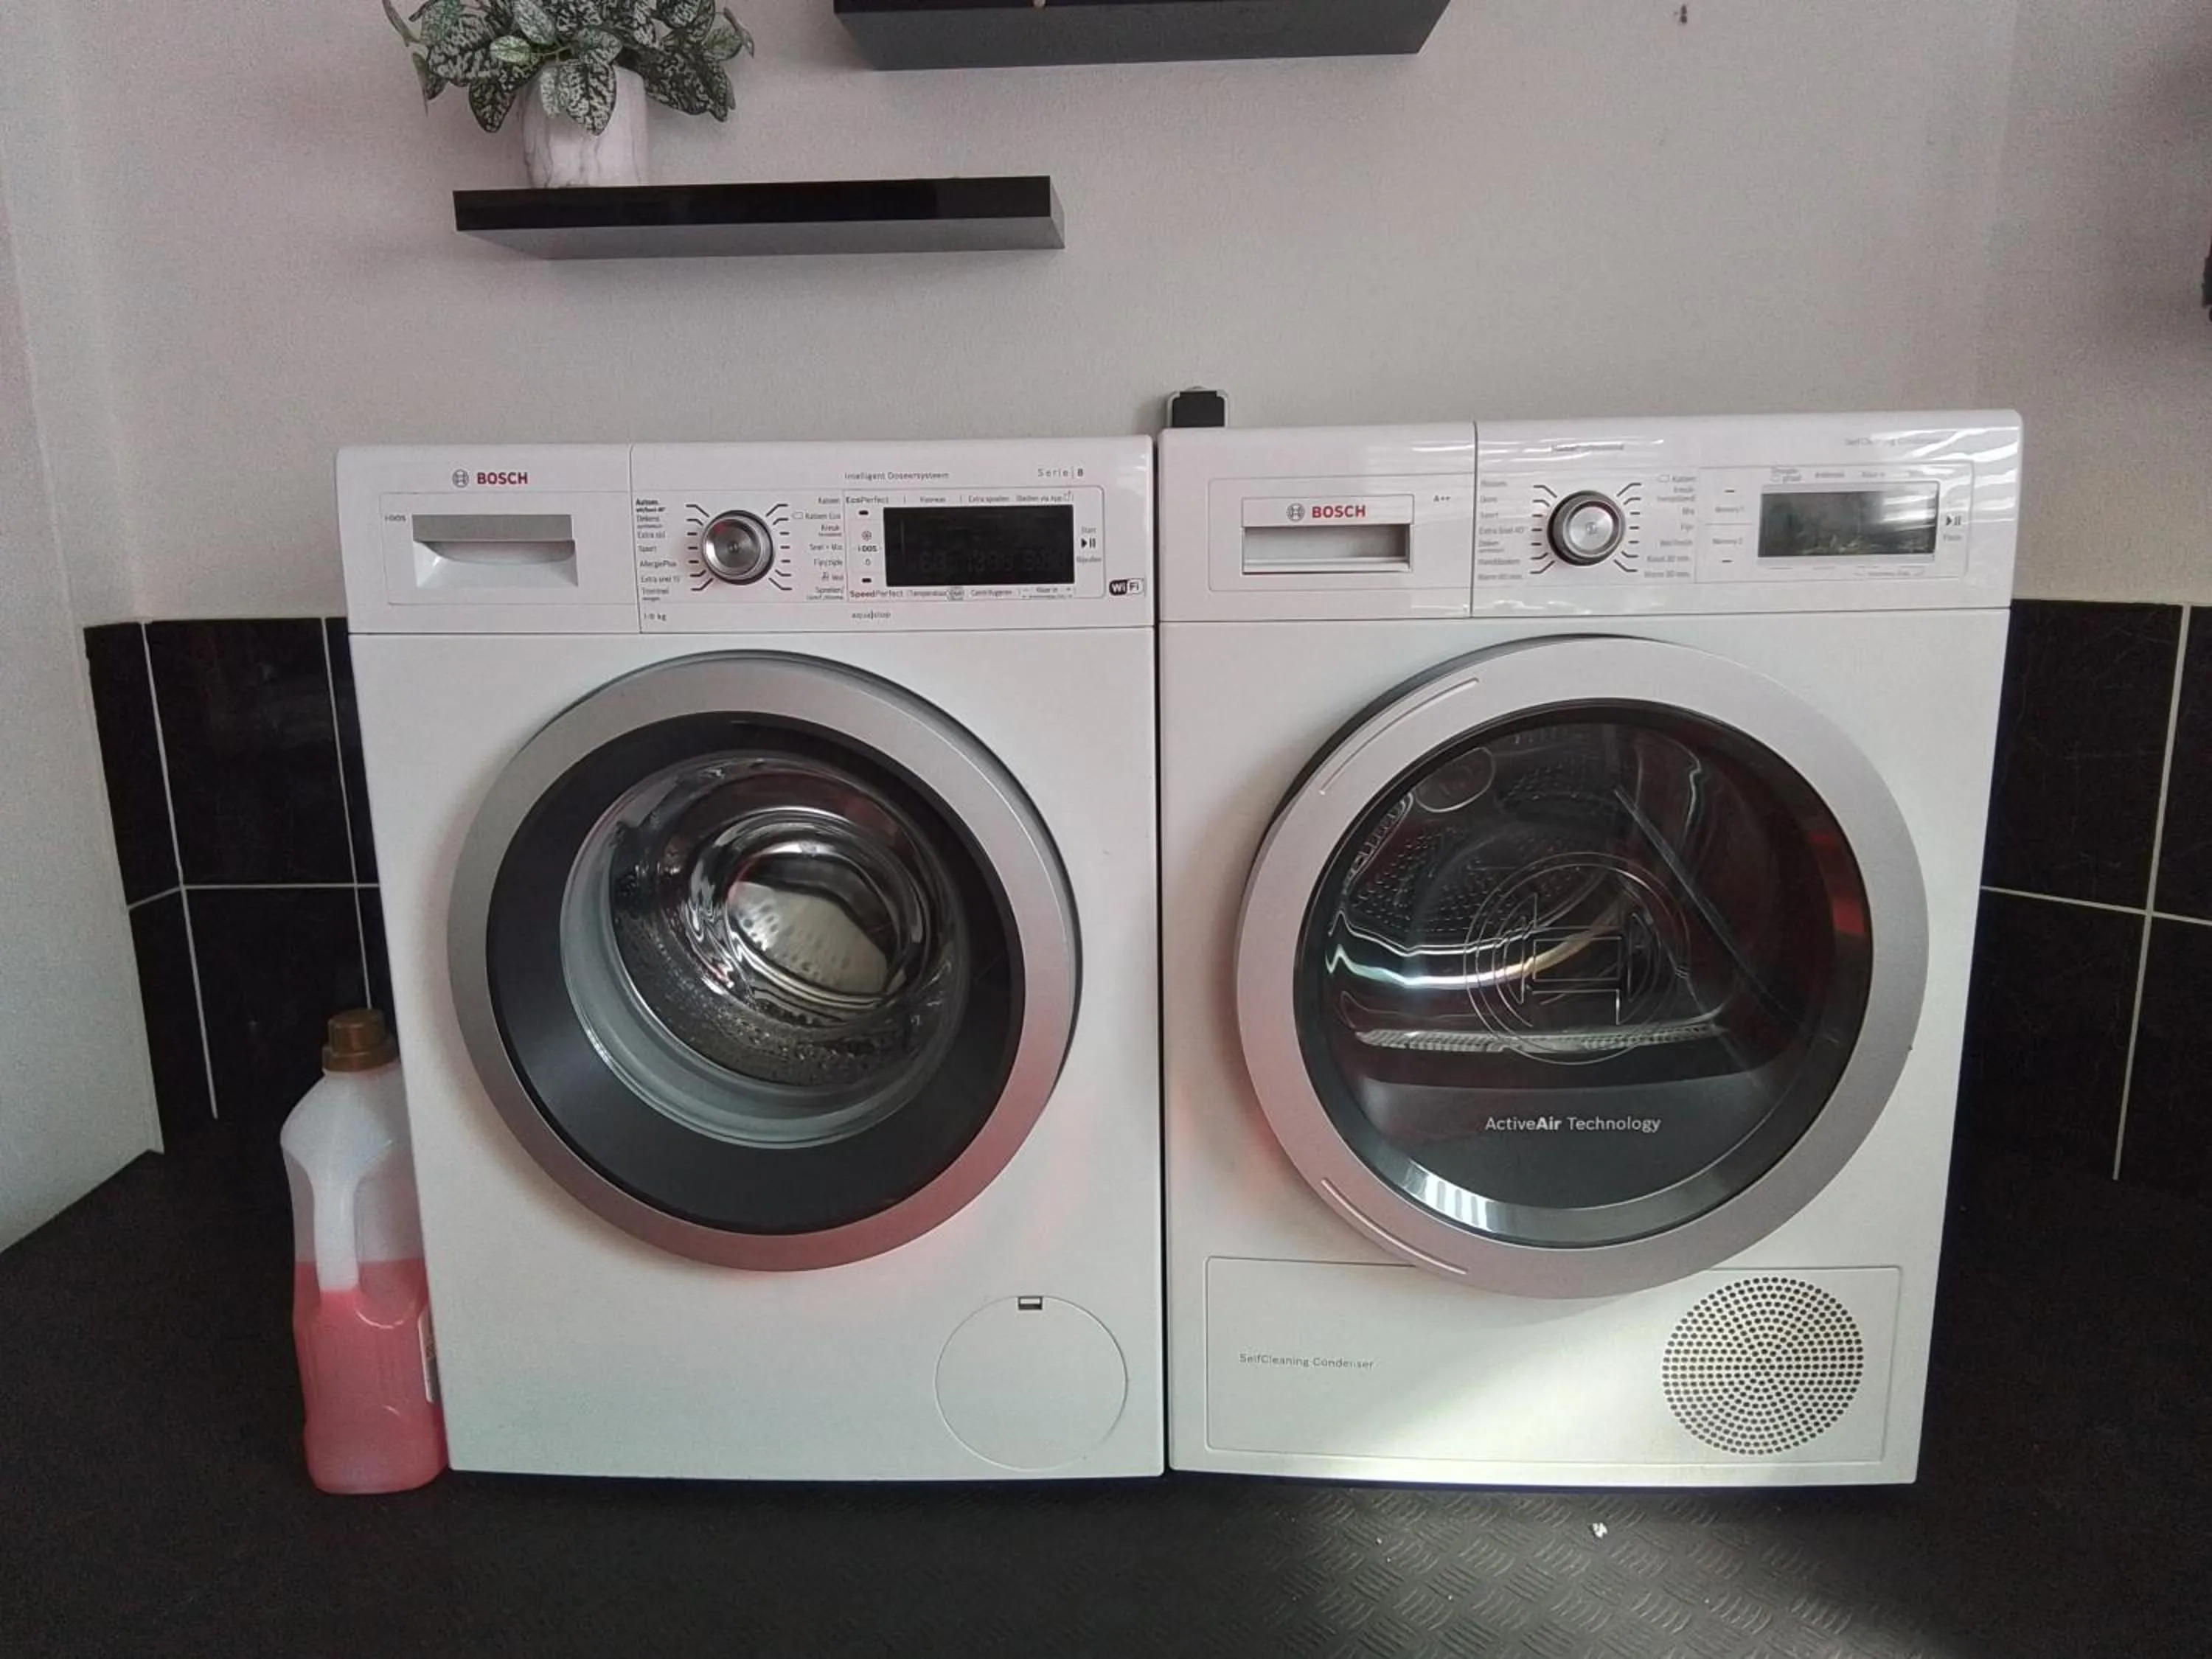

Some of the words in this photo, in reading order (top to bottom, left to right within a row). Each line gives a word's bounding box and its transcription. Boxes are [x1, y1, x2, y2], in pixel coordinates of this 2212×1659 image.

[476, 472, 528, 484] BOSCH
[1312, 505, 1366, 518] BOSCH
[1485, 1117, 1562, 1131] ActiveAir
[1566, 1116, 1661, 1133] Technology
[1239, 1353, 1310, 1368] SelfCleaning
